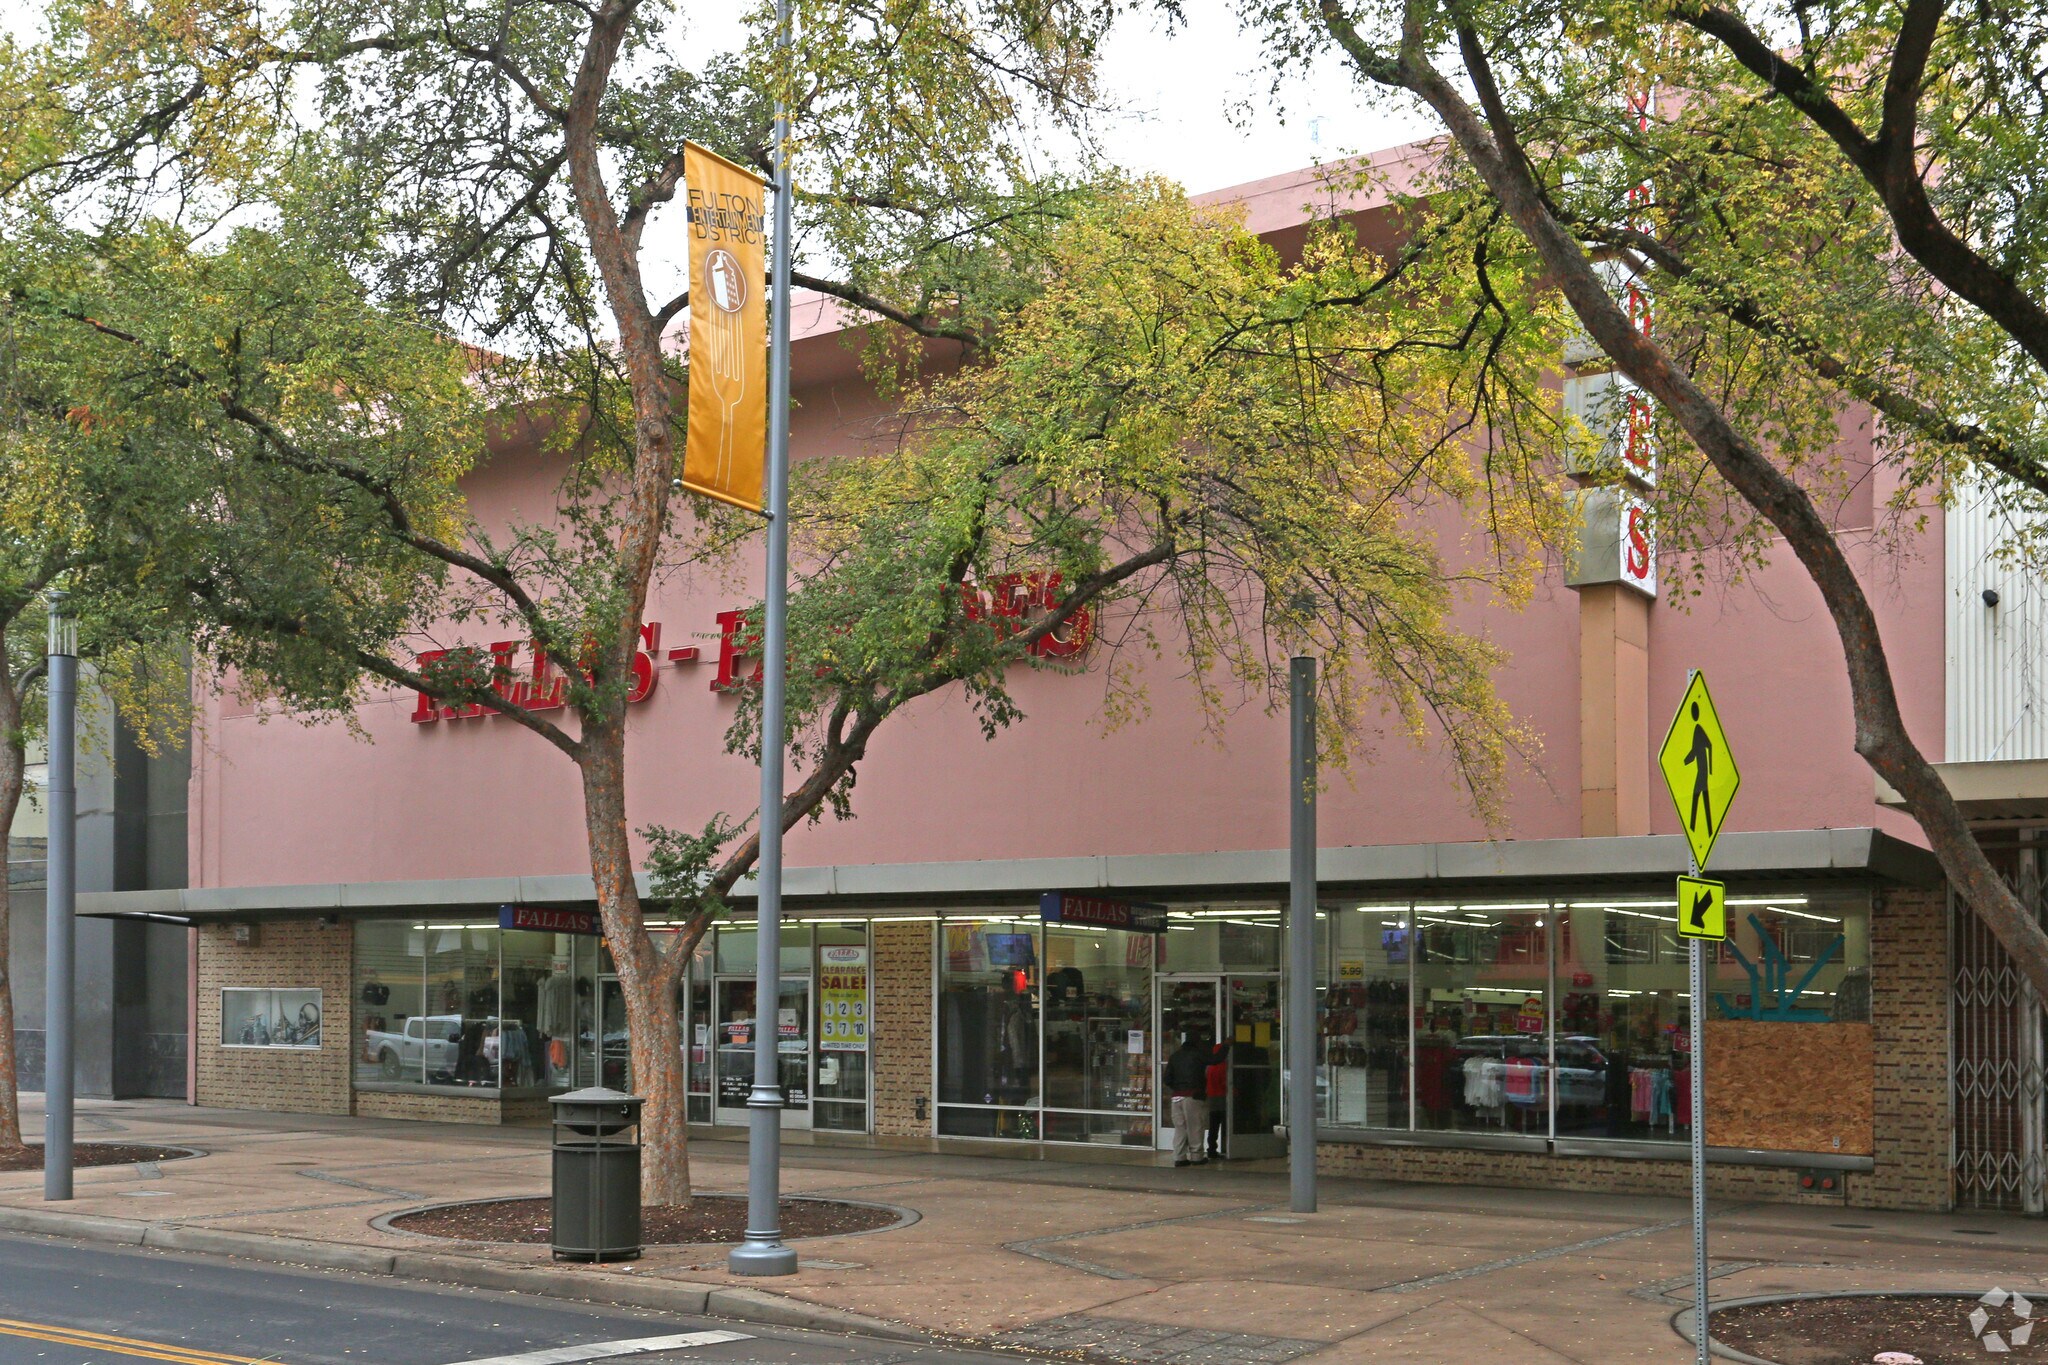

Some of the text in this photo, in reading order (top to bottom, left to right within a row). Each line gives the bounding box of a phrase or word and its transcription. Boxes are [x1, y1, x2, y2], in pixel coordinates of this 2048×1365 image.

[688, 189, 760, 215] FULTON
[692, 207, 763, 231] ENTERTAINMENT
[695, 222, 763, 245] DISTRICT
[516, 909, 589, 930] FALLAS
[1062, 897, 1128, 923] FALLAS
[822, 966, 866, 975] CLEARANCE
[821, 975, 866, 990] SALE!
